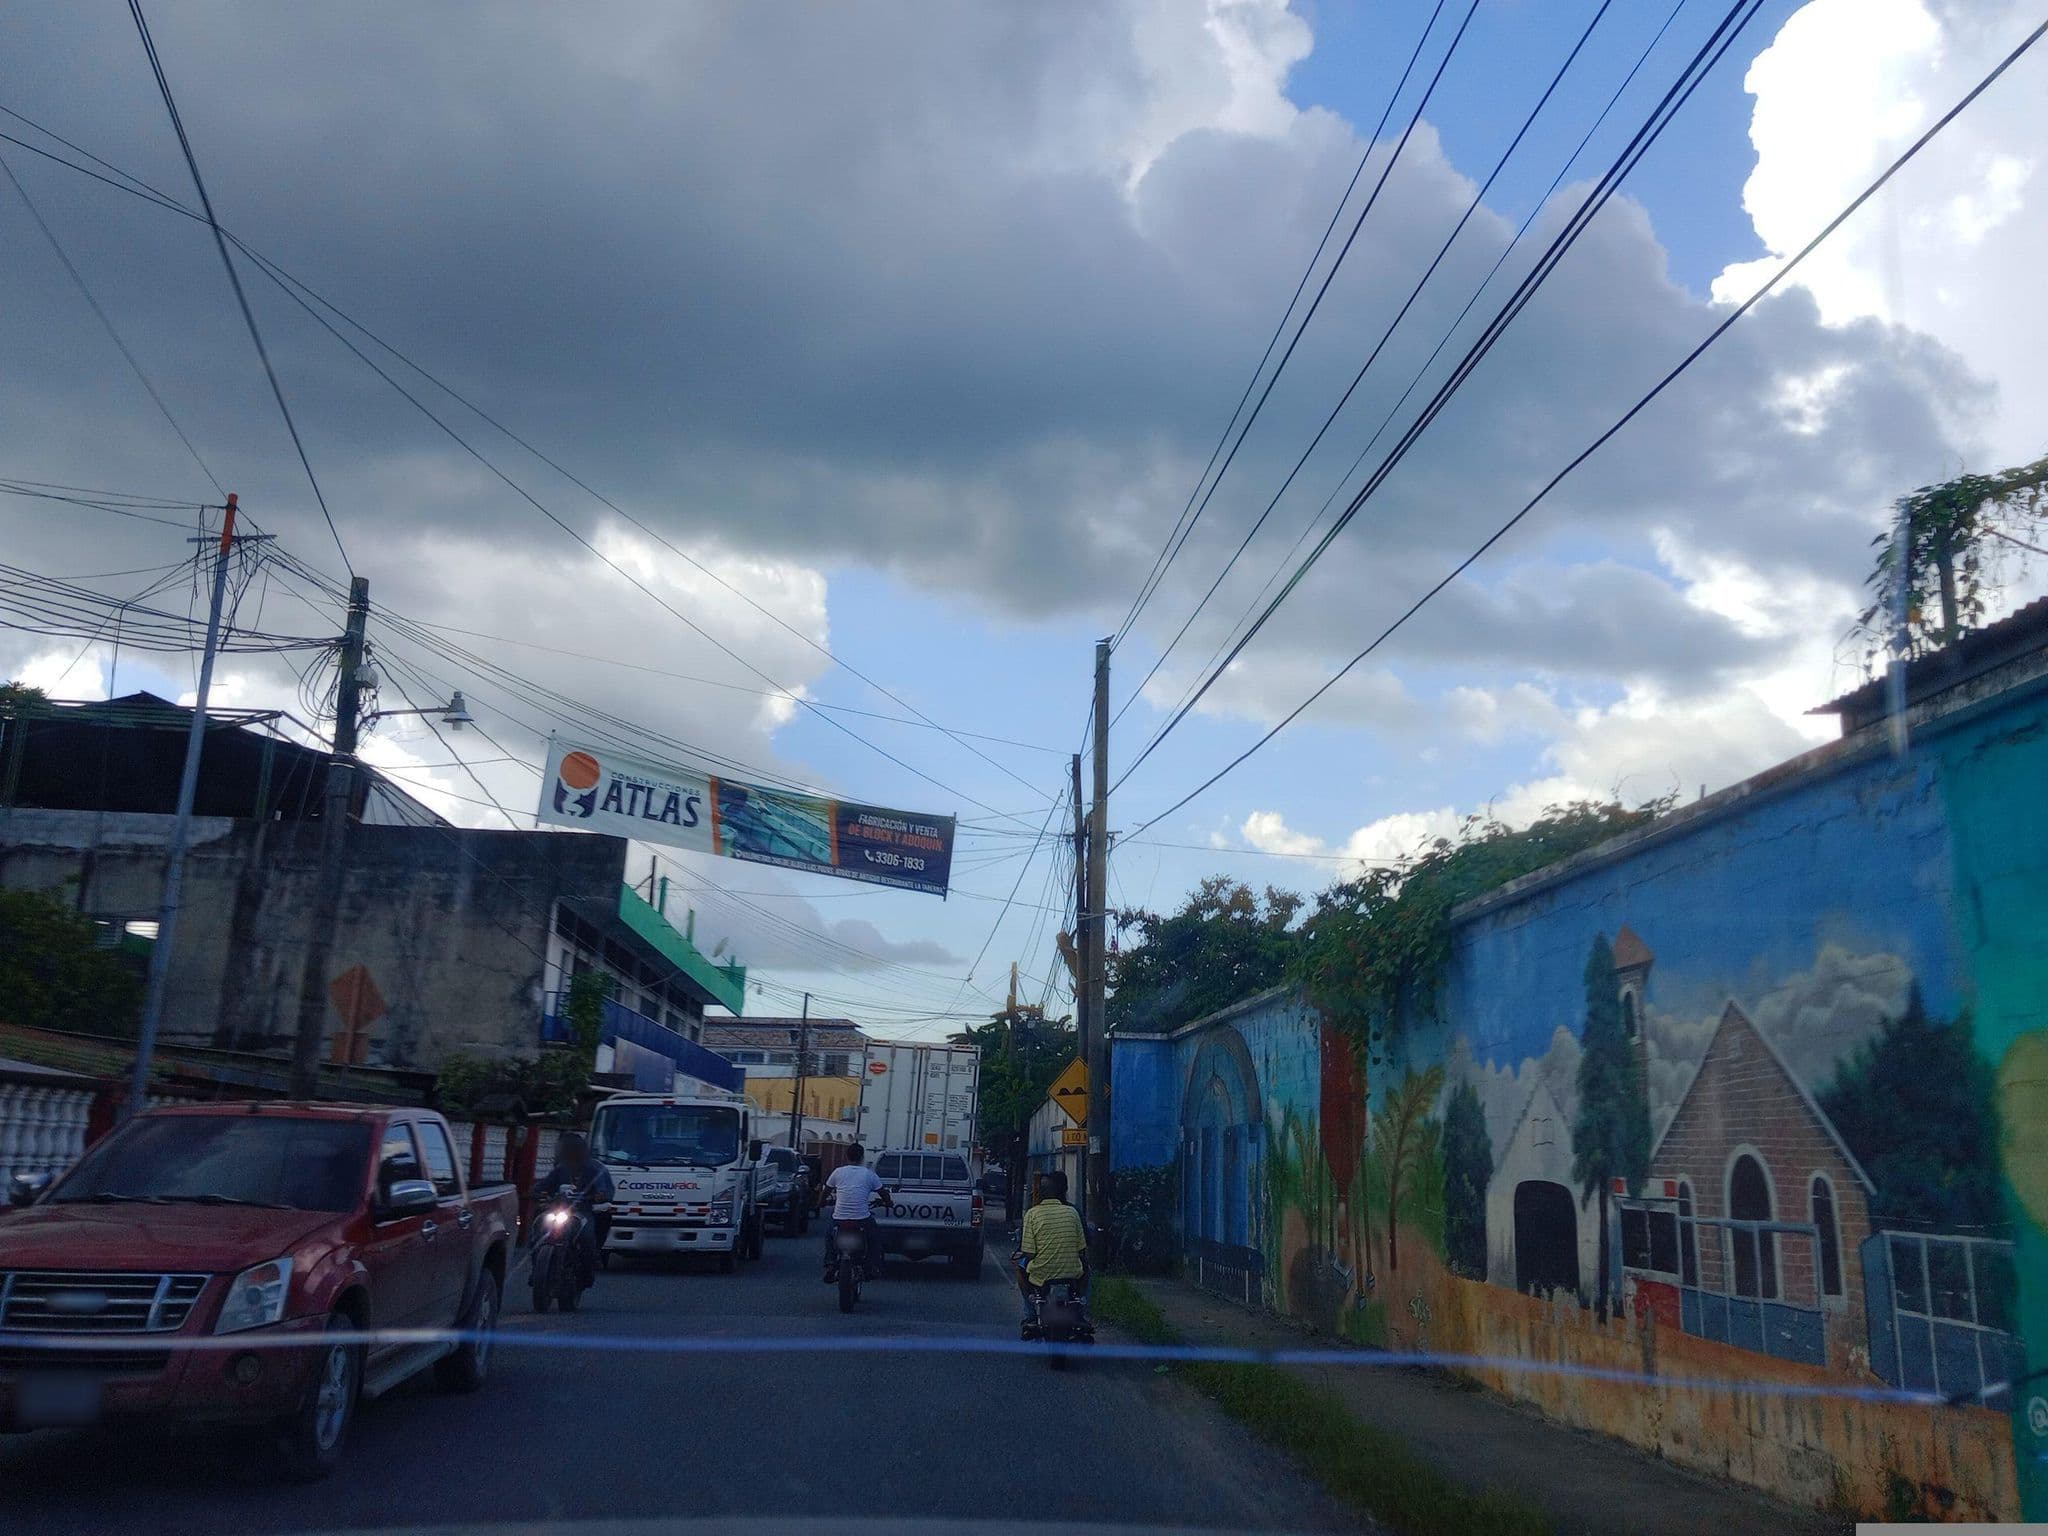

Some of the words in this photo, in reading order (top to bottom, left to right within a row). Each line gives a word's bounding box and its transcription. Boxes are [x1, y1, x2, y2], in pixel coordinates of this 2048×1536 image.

[611, 771, 700, 796] CONSTRUCCIONES
[600, 780, 701, 828] ATLAS
[847, 823, 861, 837] DE
[894, 831, 901, 844] Y
[859, 813, 907, 832] FABRICACIÓN
[908, 821, 915, 834] Y
[915, 824, 938, 838] VENTA
[874, 850, 925, 871] 3306-1833
[883, 1204, 954, 1219] TOYOTA
